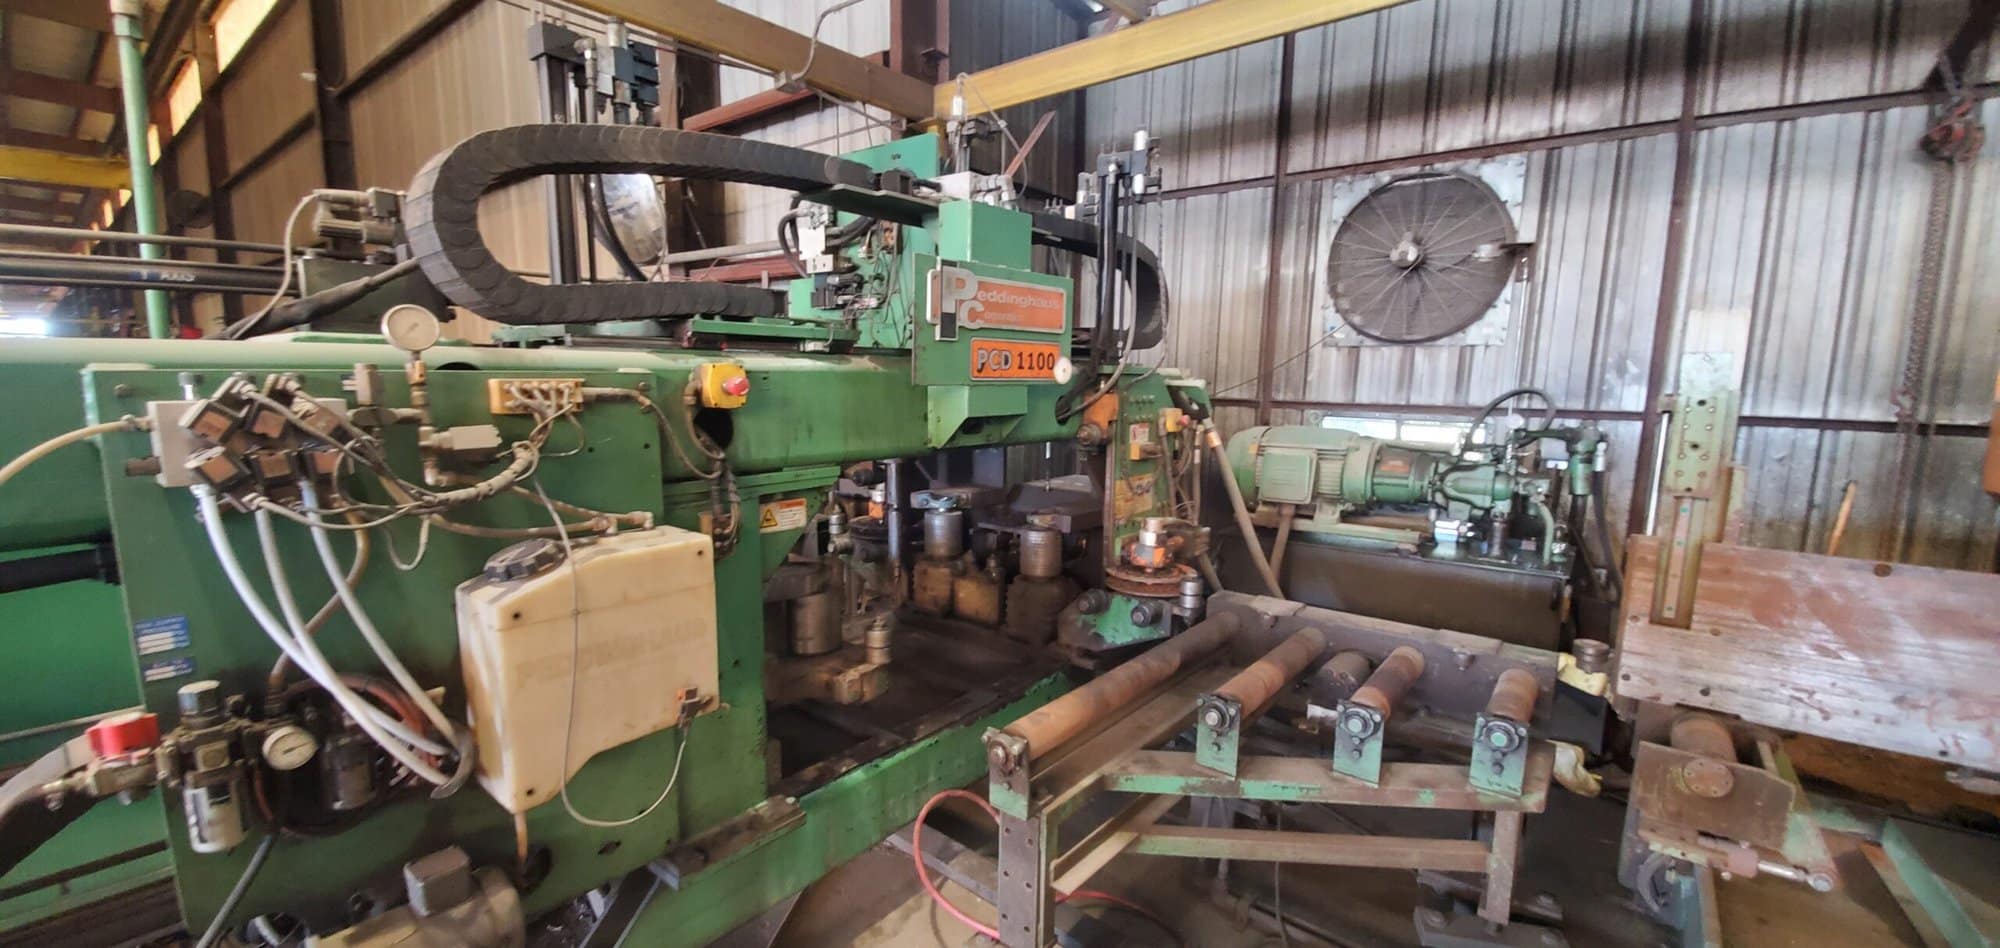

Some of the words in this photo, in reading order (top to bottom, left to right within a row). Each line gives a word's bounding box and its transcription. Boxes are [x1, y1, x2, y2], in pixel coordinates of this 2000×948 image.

[941, 265, 1060, 313] Peddinghaus
[976, 347, 1013, 374] PCD
[1017, 351, 1056, 371] 1100
